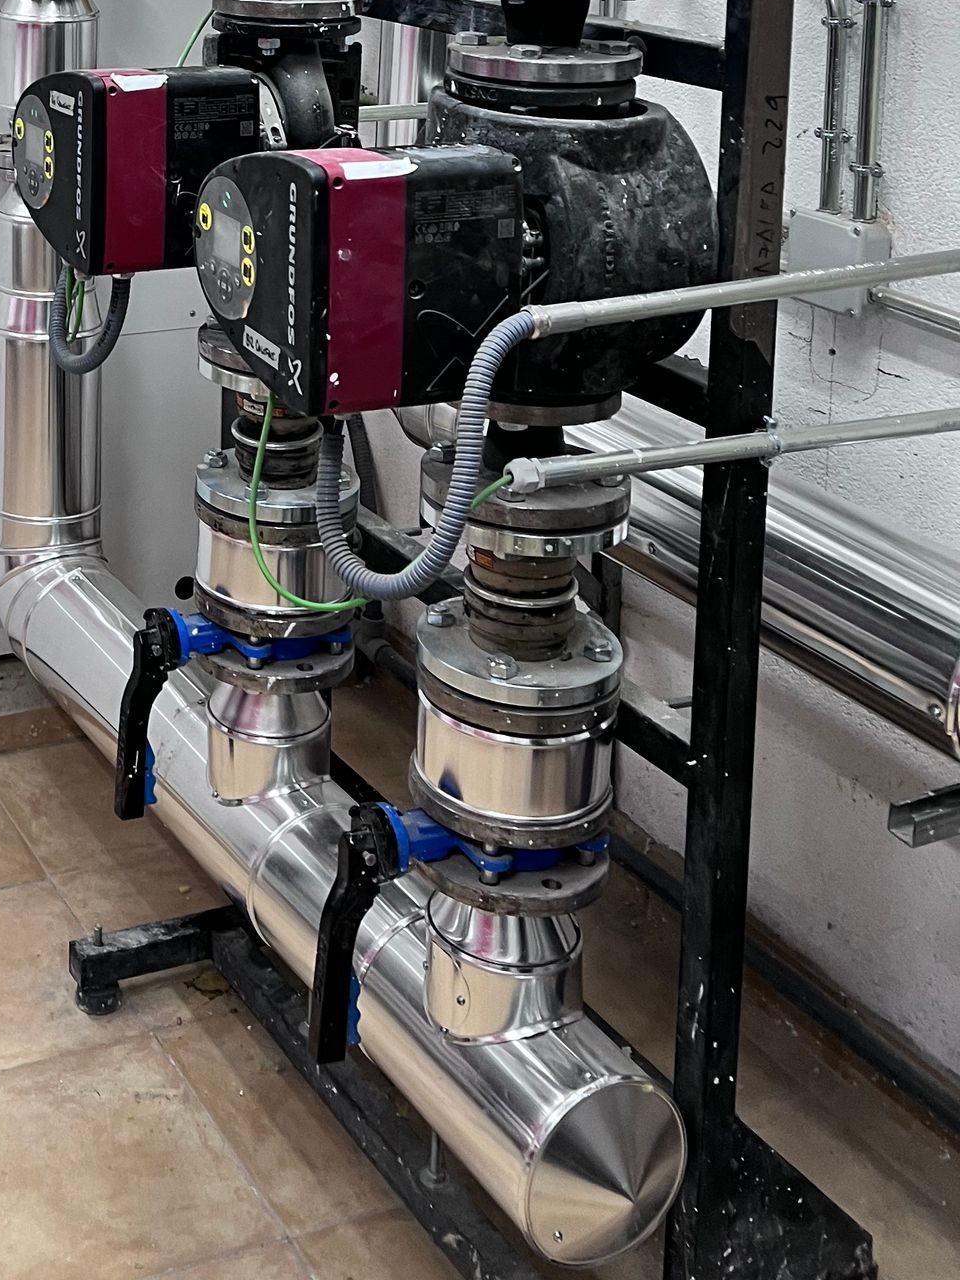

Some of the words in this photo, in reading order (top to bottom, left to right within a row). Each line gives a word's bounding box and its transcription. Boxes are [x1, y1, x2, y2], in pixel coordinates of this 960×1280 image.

[75, 90, 83, 221] GRUNDFOS
[762, 95, 789, 155] 229
[287, 182, 297, 346] GRUNDFOS
